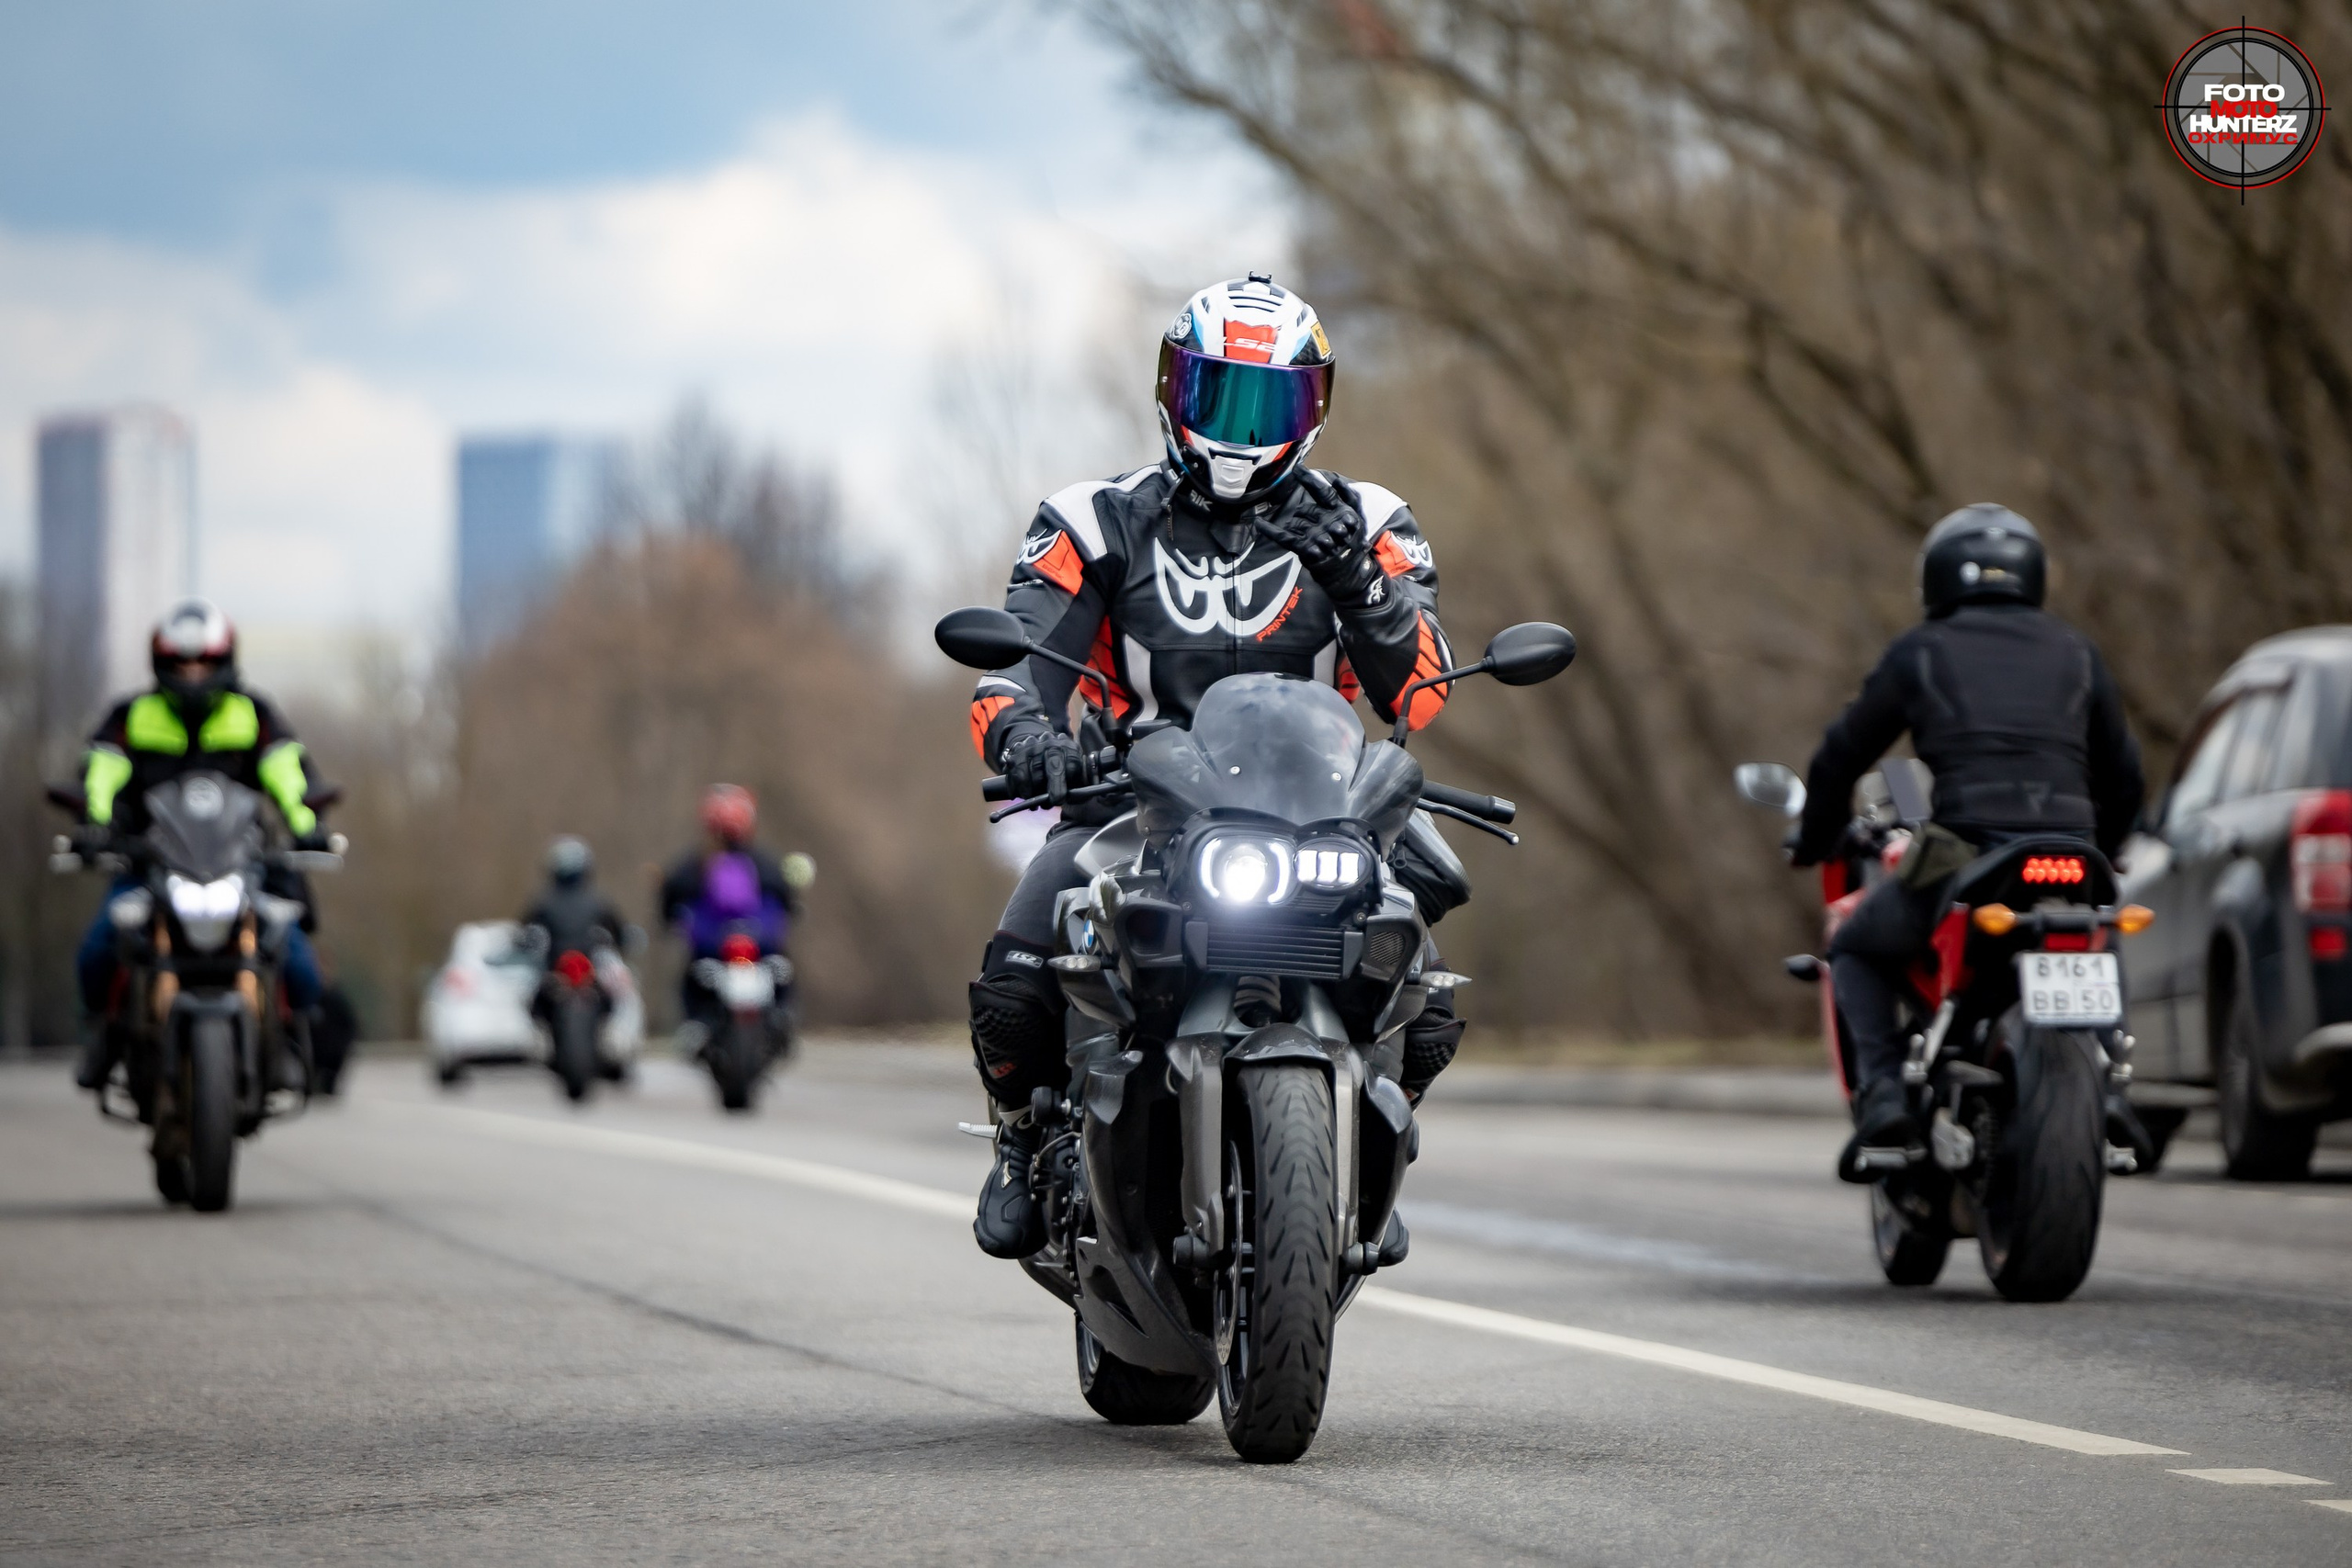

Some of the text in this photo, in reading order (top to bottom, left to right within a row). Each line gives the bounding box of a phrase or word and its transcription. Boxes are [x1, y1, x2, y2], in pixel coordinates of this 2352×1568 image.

[1256, 585, 1303, 642] PRINTEK
[2037, 955, 2104, 978] 8161
[2081, 988, 2113, 1010] 50
